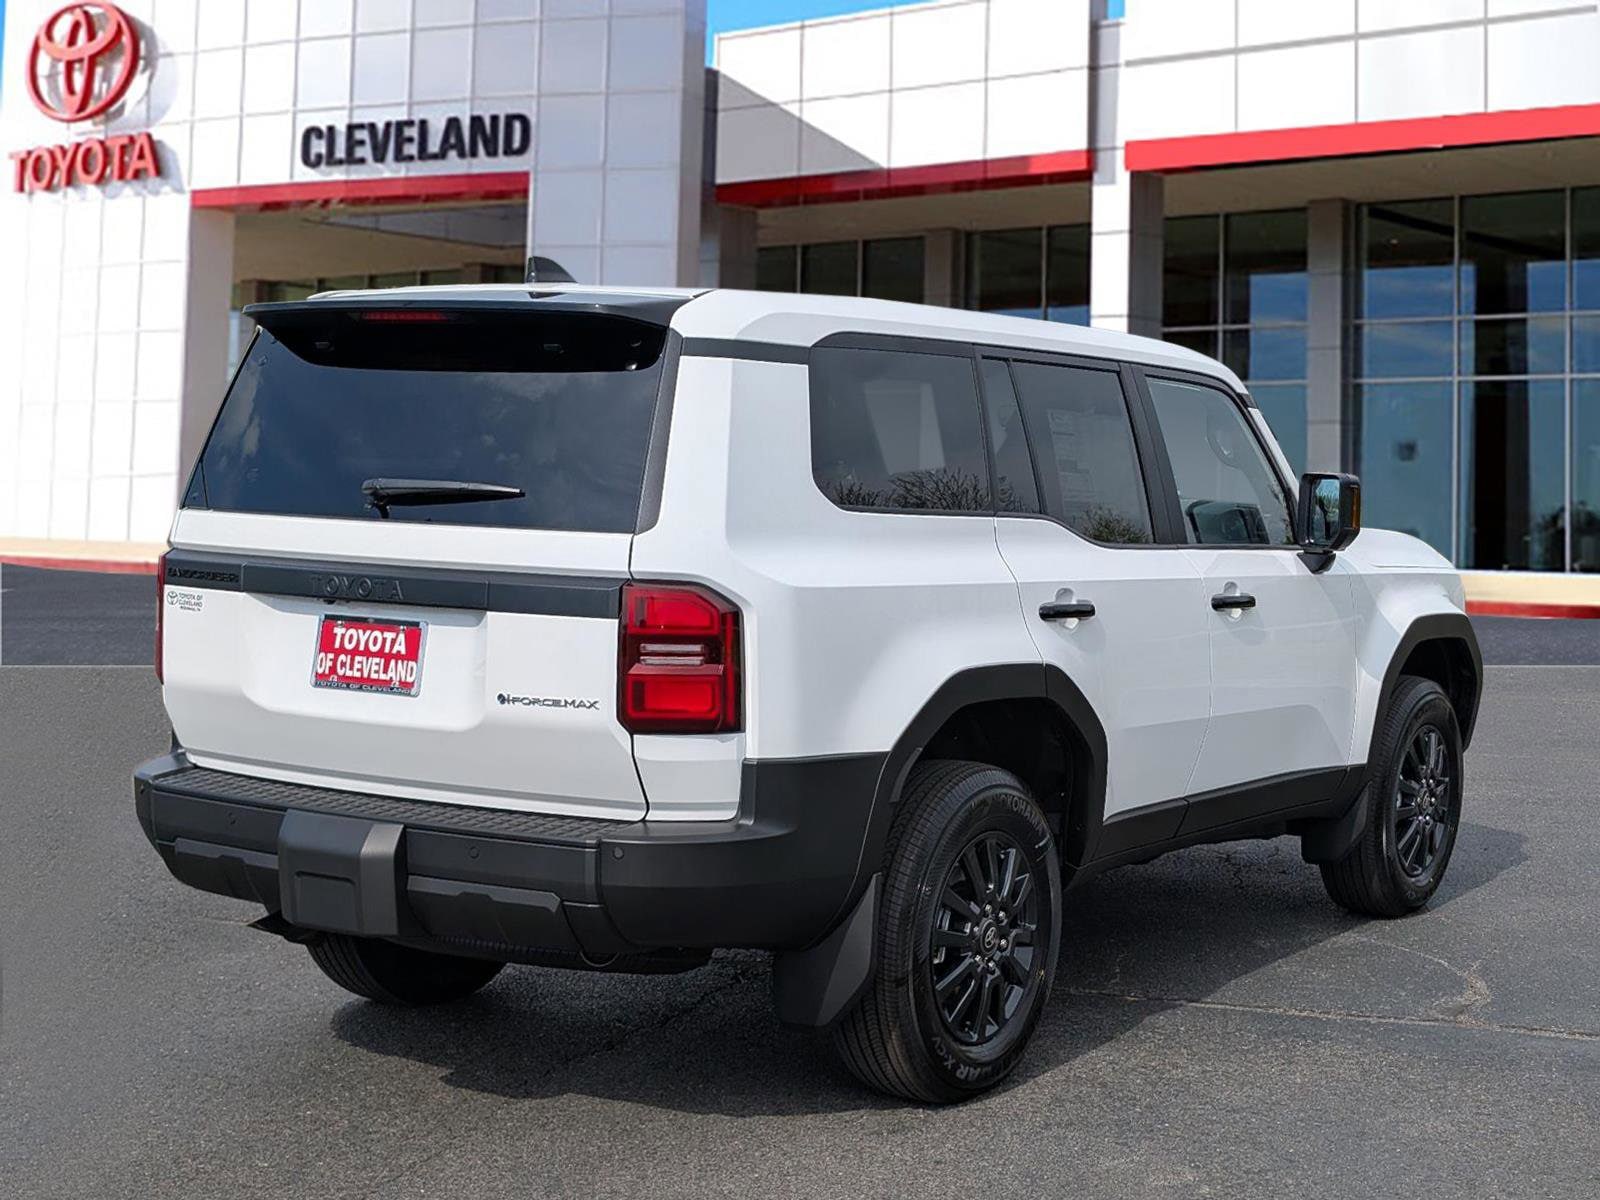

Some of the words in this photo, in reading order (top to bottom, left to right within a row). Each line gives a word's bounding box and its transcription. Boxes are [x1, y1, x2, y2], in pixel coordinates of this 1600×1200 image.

[301, 113, 531, 168] CLEVELAND
[8, 132, 160, 193] TOYOTA
[312, 575, 404, 600] TOYOTA
[333, 627, 406, 655] TOYOTA
[317, 652, 334, 674] OF
[336, 654, 417, 683] CLEVELAND
[317, 680, 348, 688] TOYOTA
[361, 684, 411, 694] CLEVELAND
